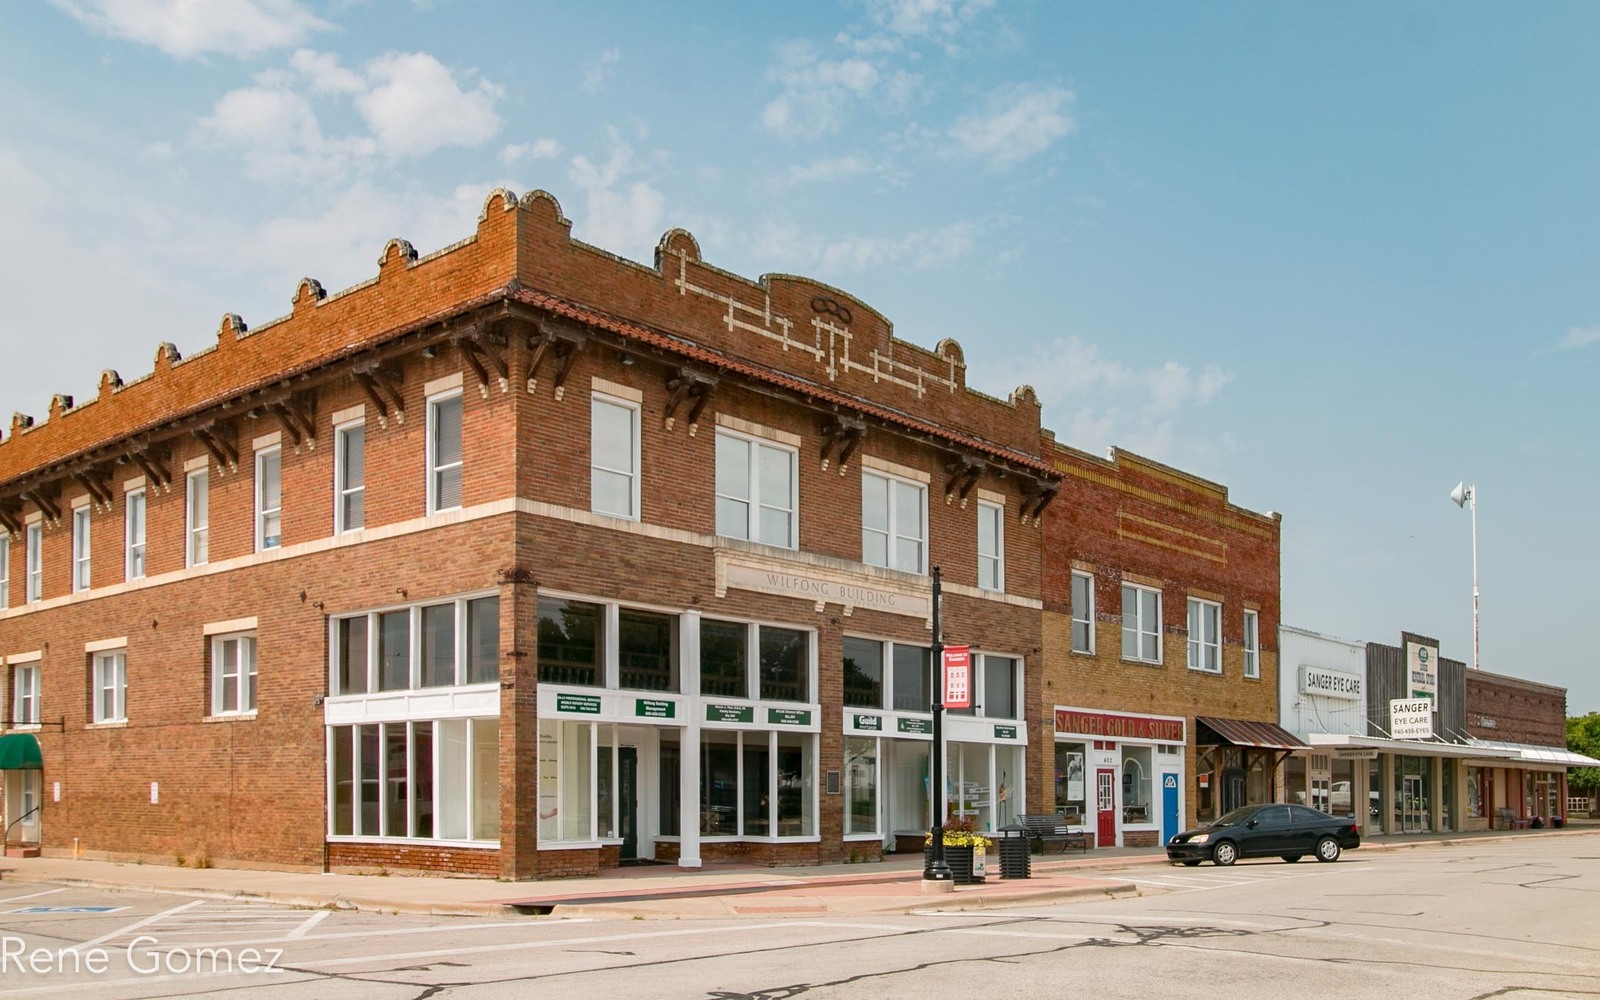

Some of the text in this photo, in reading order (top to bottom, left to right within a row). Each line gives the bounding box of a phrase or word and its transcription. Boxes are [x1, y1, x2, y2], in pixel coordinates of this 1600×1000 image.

[767, 573, 896, 606] WILFONG BUILDING
[1308, 672, 1360, 694] SANGER EYE CARE
[1393, 702, 1429, 713] SANGER
[859, 715, 877, 725] Guild
[1056, 713, 1102, 735] SANGER
[1107, 718, 1135, 737] GOLD
[1139, 723, 1145, 738] &
[1409, 716, 1428, 724] CARE
